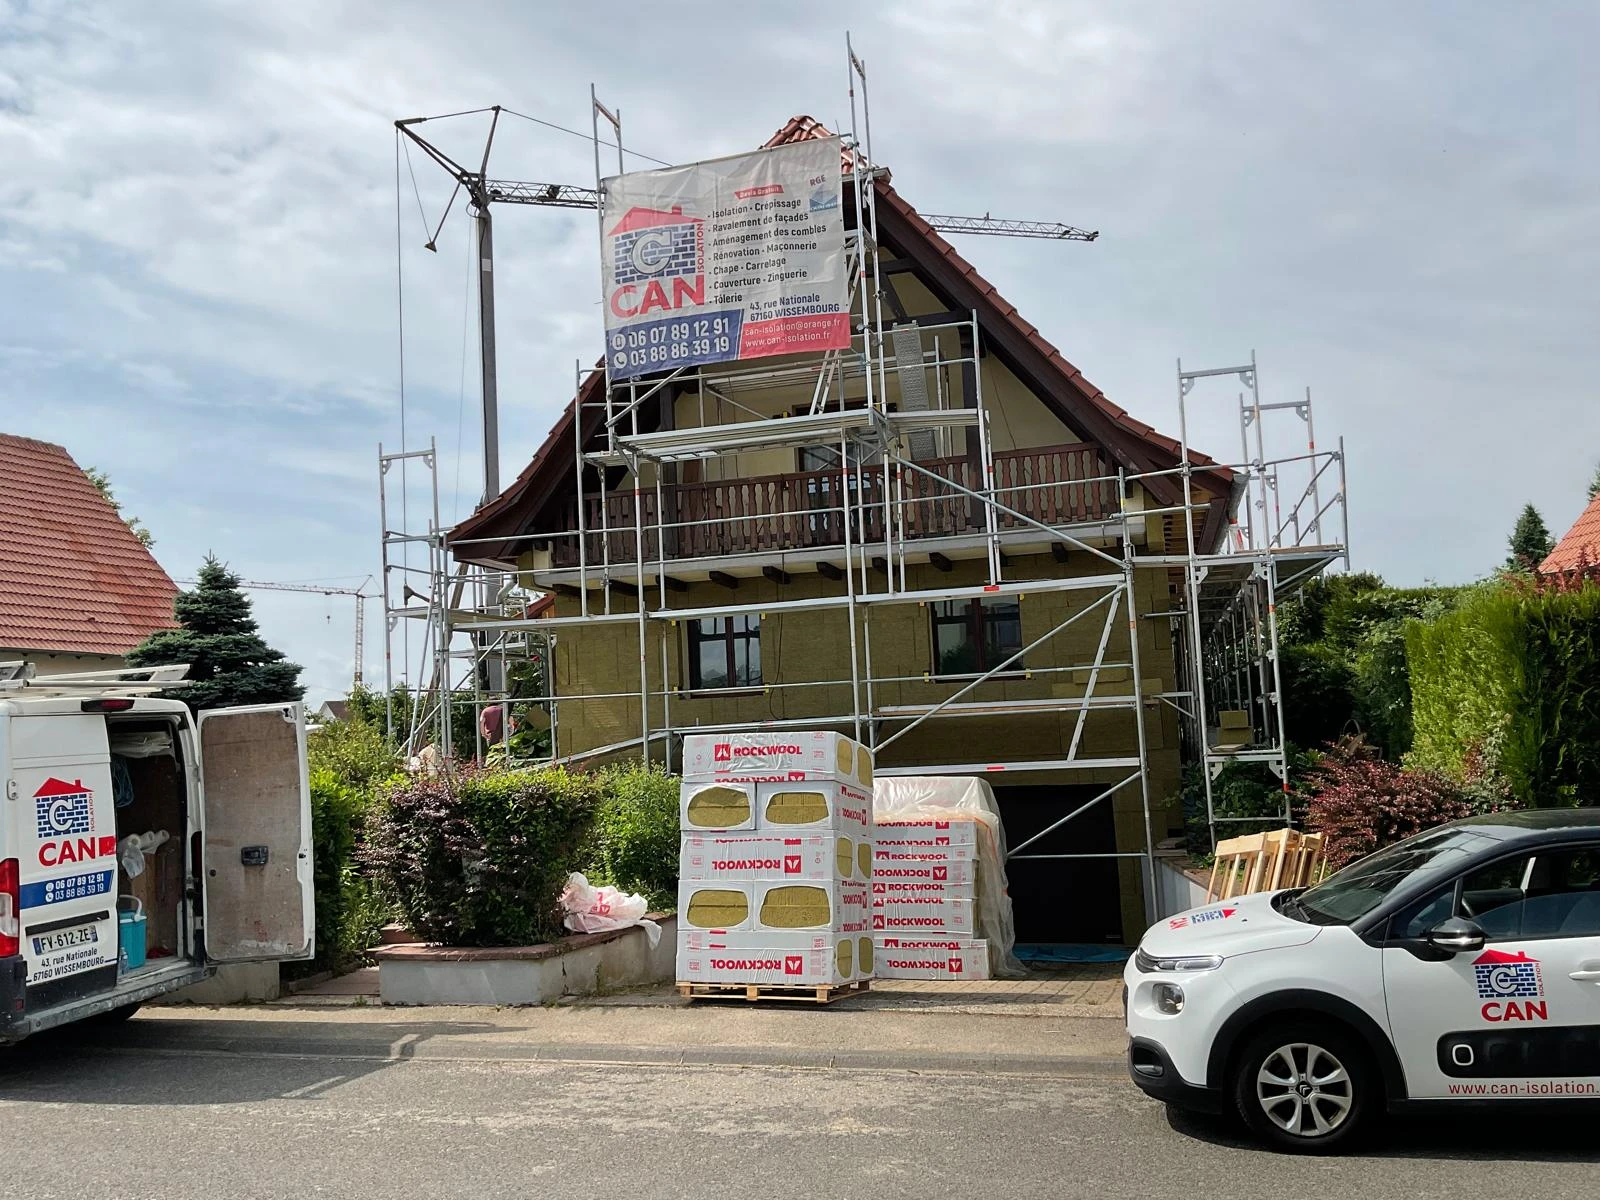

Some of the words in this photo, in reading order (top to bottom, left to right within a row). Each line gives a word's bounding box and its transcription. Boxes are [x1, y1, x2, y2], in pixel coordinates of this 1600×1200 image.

[810, 175, 826, 186] RGE
[712, 206, 748, 218] Isolation
[754, 199, 801, 213] Crépissage
[712, 218, 762, 232] Ravalement
[764, 216, 773, 225] de
[775, 212, 809, 224] façades
[712, 230, 772, 247] Aménagement
[774, 228, 789, 237] des
[792, 224, 827, 236] combles
[696, 223, 705, 273] ISOLATION
[713, 247, 760, 261] Rénovation
[766, 242, 817, 255] Maçonnerie
[714, 264, 739, 276] Chape
[746, 258, 786, 271] Carrelage
[714, 276, 761, 290] Couverture
[768, 270, 808, 283] Zinguerie
[610, 275, 705, 319] CAN
[750, 302, 762, 312] 43,
[764, 300, 777, 309] rue
[780, 293, 820, 306] Nationale
[750, 311, 773, 321] 67160
[774, 304, 840, 317] WISSEMBOURG
[628, 330, 646, 348] 06
[650, 326, 667, 344] 07
[671, 322, 690, 340] 89
[694, 320, 709, 337] 12
[713, 317, 729, 334] 91
[745, 319, 840, 336] can-isolation@orange.fr
[745, 331, 831, 348] www.can-isolation.fr
[630, 349, 646, 366] 03
[650, 345, 668, 362] 88
[671, 342, 689, 359] 86
[692, 339, 710, 356] 39
[714, 336, 729, 353] 19
[734, 745, 802, 757] ROCKWOOL
[38, 836, 96, 866] CAN
[712, 860, 781, 870] ROCKWOOL
[55, 880, 65, 890] 06
[67, 879, 75, 887] 07
[77, 877, 86, 886] 89
[88, 875, 95, 884] 12
[97, 873, 104, 882] 91
[55, 891, 64, 900] 03
[66, 888, 75, 898] 88
[77, 887, 85, 896] 86
[87, 885, 96, 894] 39
[97, 883, 104, 892] 19
[40, 928, 90, 951] FV-612-ZE
[41, 959, 51, 968] 43,
[53, 956, 64, 965] rue
[66, 947, 97, 961] Nationale
[710, 959, 782, 970] ROCKWOOL
[887, 960, 945, 968] ROCKWOOL
[33, 969, 52, 981] 67160
[54, 956, 104, 976] WISSEMBOURG
[1536, 962, 1545, 997] ISOLATION
[1481, 1000, 1548, 1022] CAN
